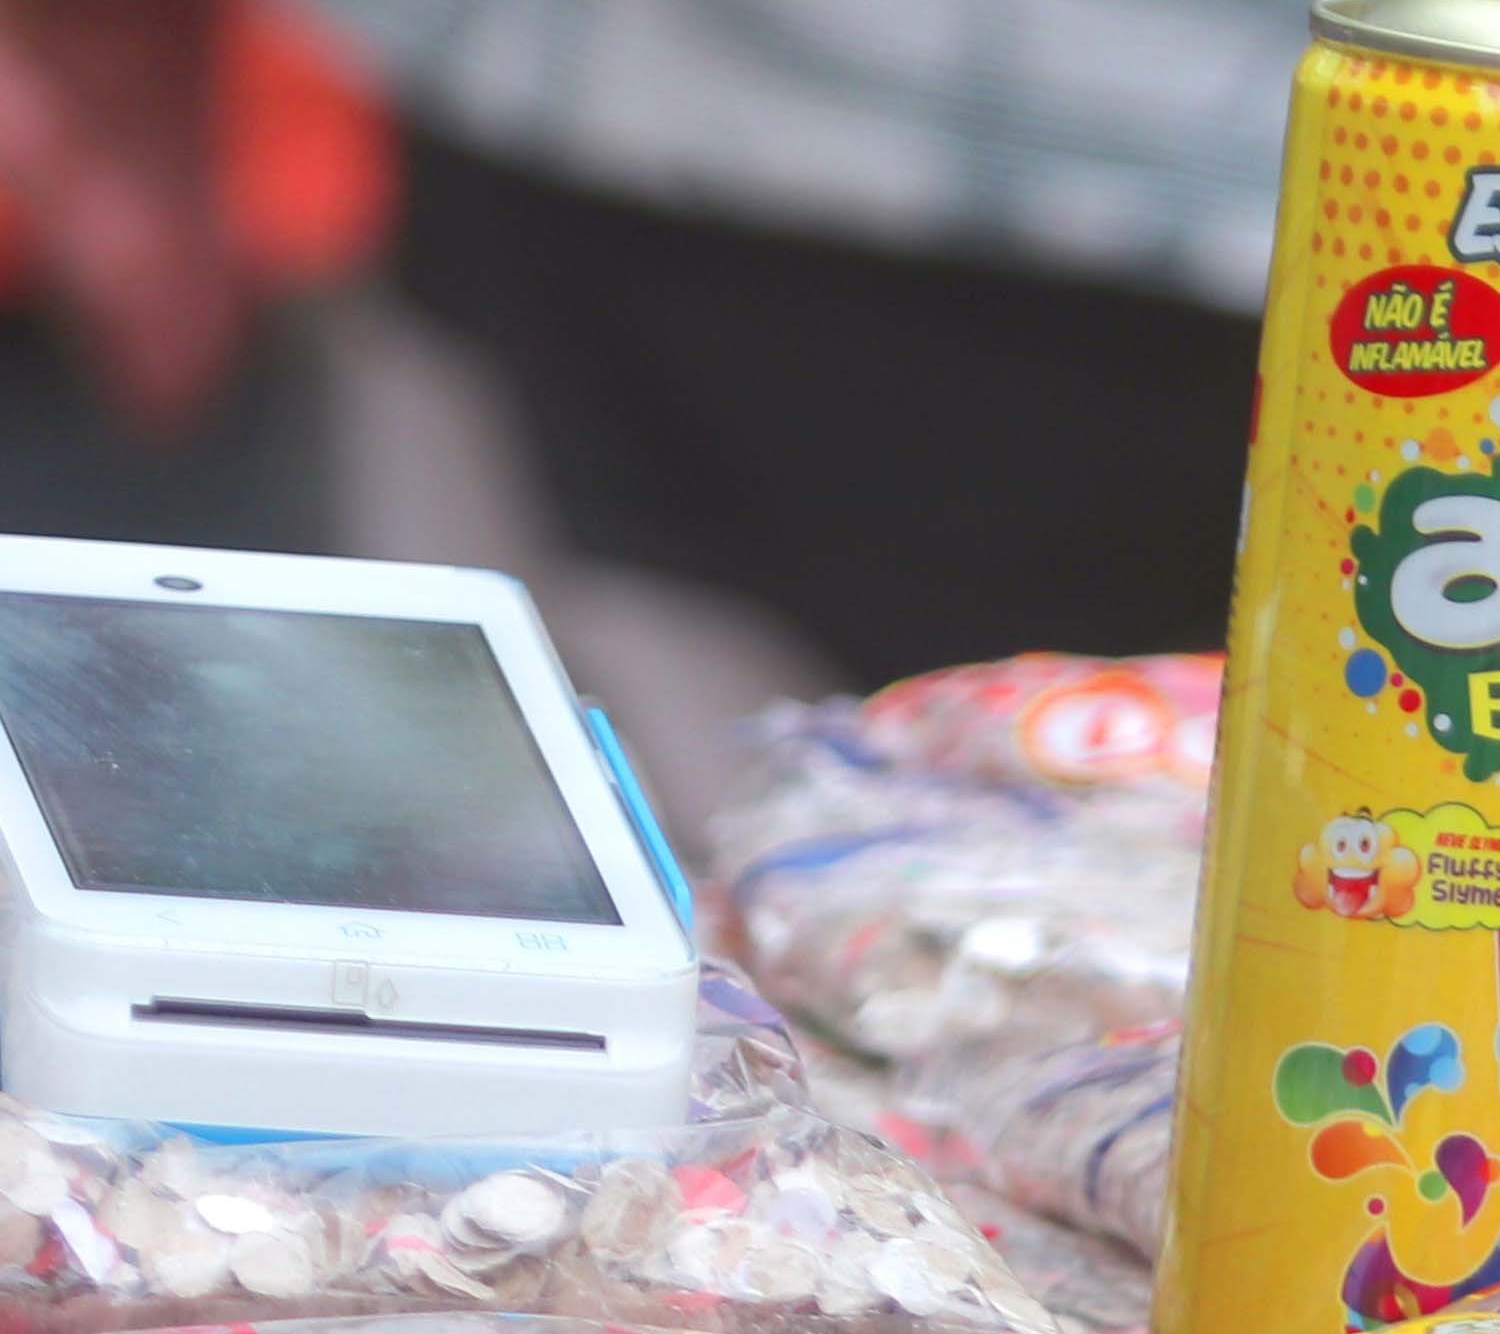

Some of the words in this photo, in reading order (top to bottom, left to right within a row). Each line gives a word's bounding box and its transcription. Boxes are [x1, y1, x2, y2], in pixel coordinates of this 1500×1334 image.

[1363, 281, 1425, 330] NÃO
[1428, 279, 1454, 329] É
[1349, 330, 1488, 372] INFLAMÁVEL
